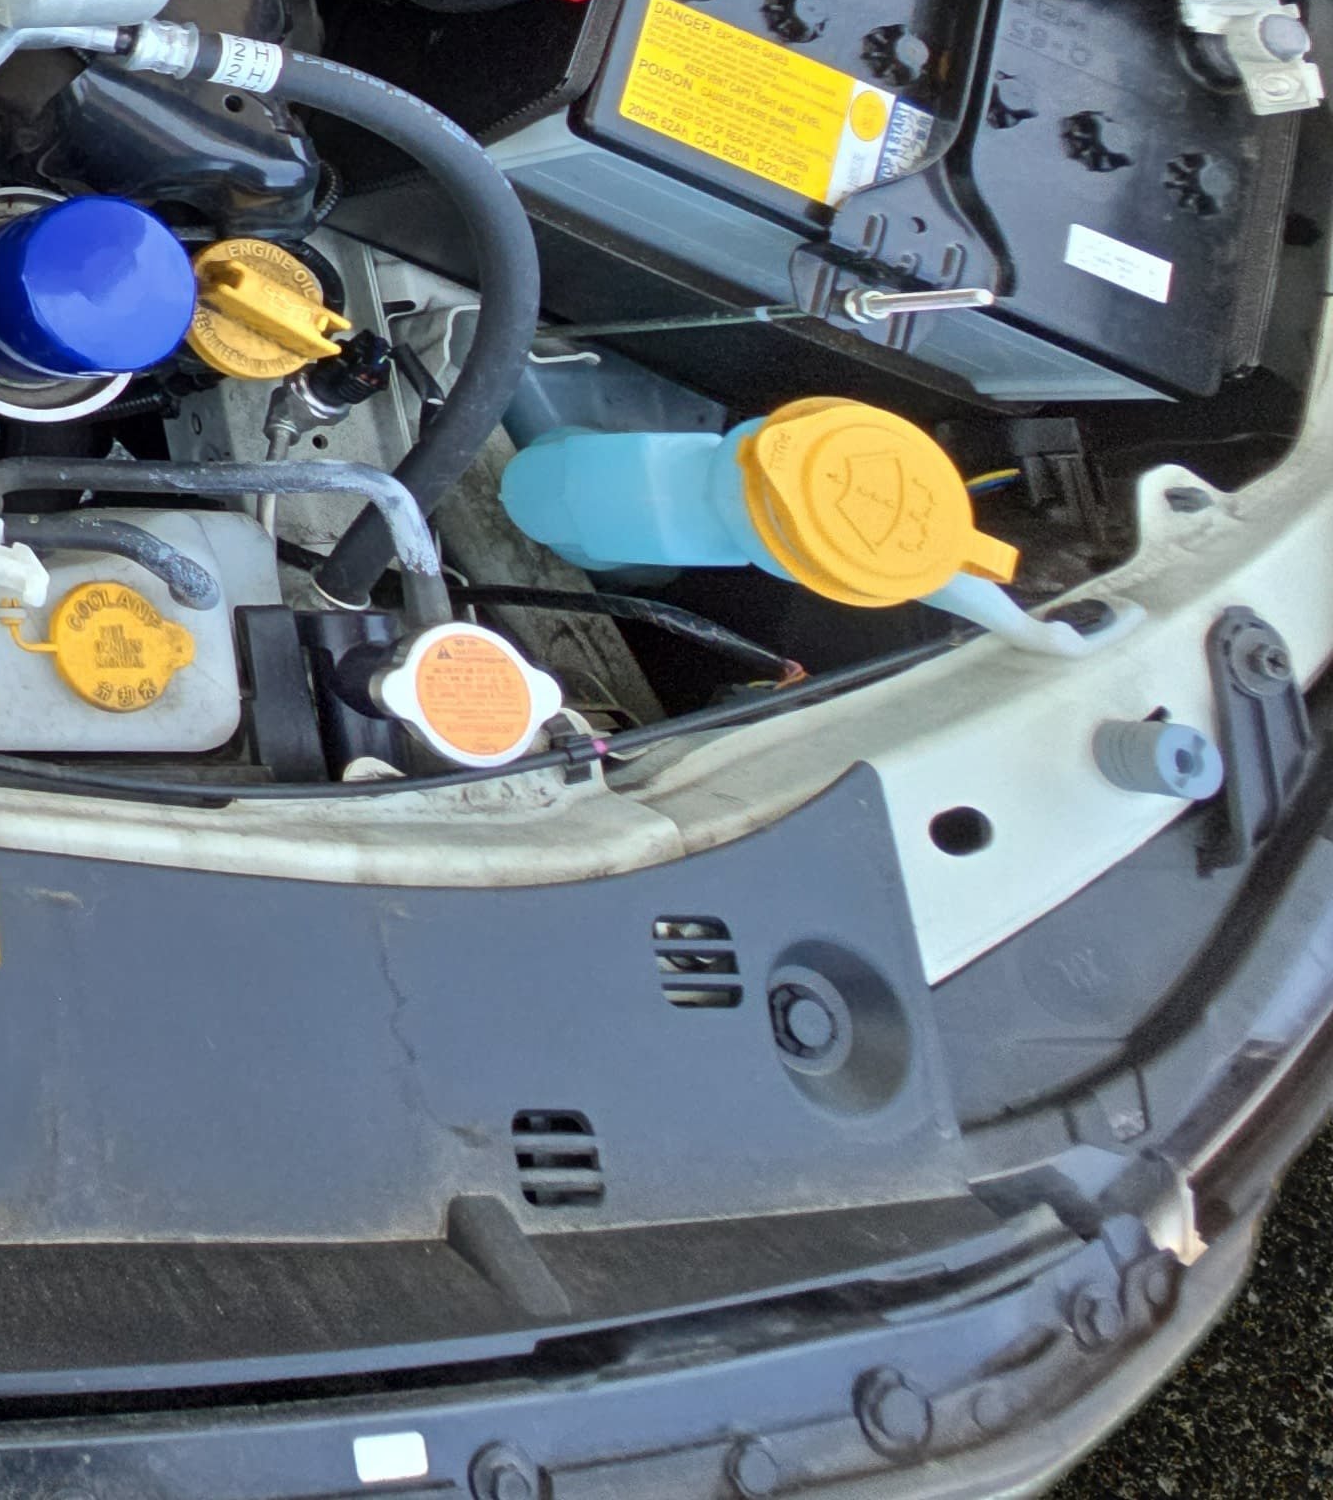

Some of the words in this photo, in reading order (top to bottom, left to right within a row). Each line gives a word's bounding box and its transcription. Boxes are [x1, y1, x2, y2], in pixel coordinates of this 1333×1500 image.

[653, 0, 712, 35] DANGER
[636, 57, 695, 92] POISON
[228, 243, 292, 270] ENGINE
[293, 269, 317, 299] OIL
[65, 589, 164, 632] COOLANT
